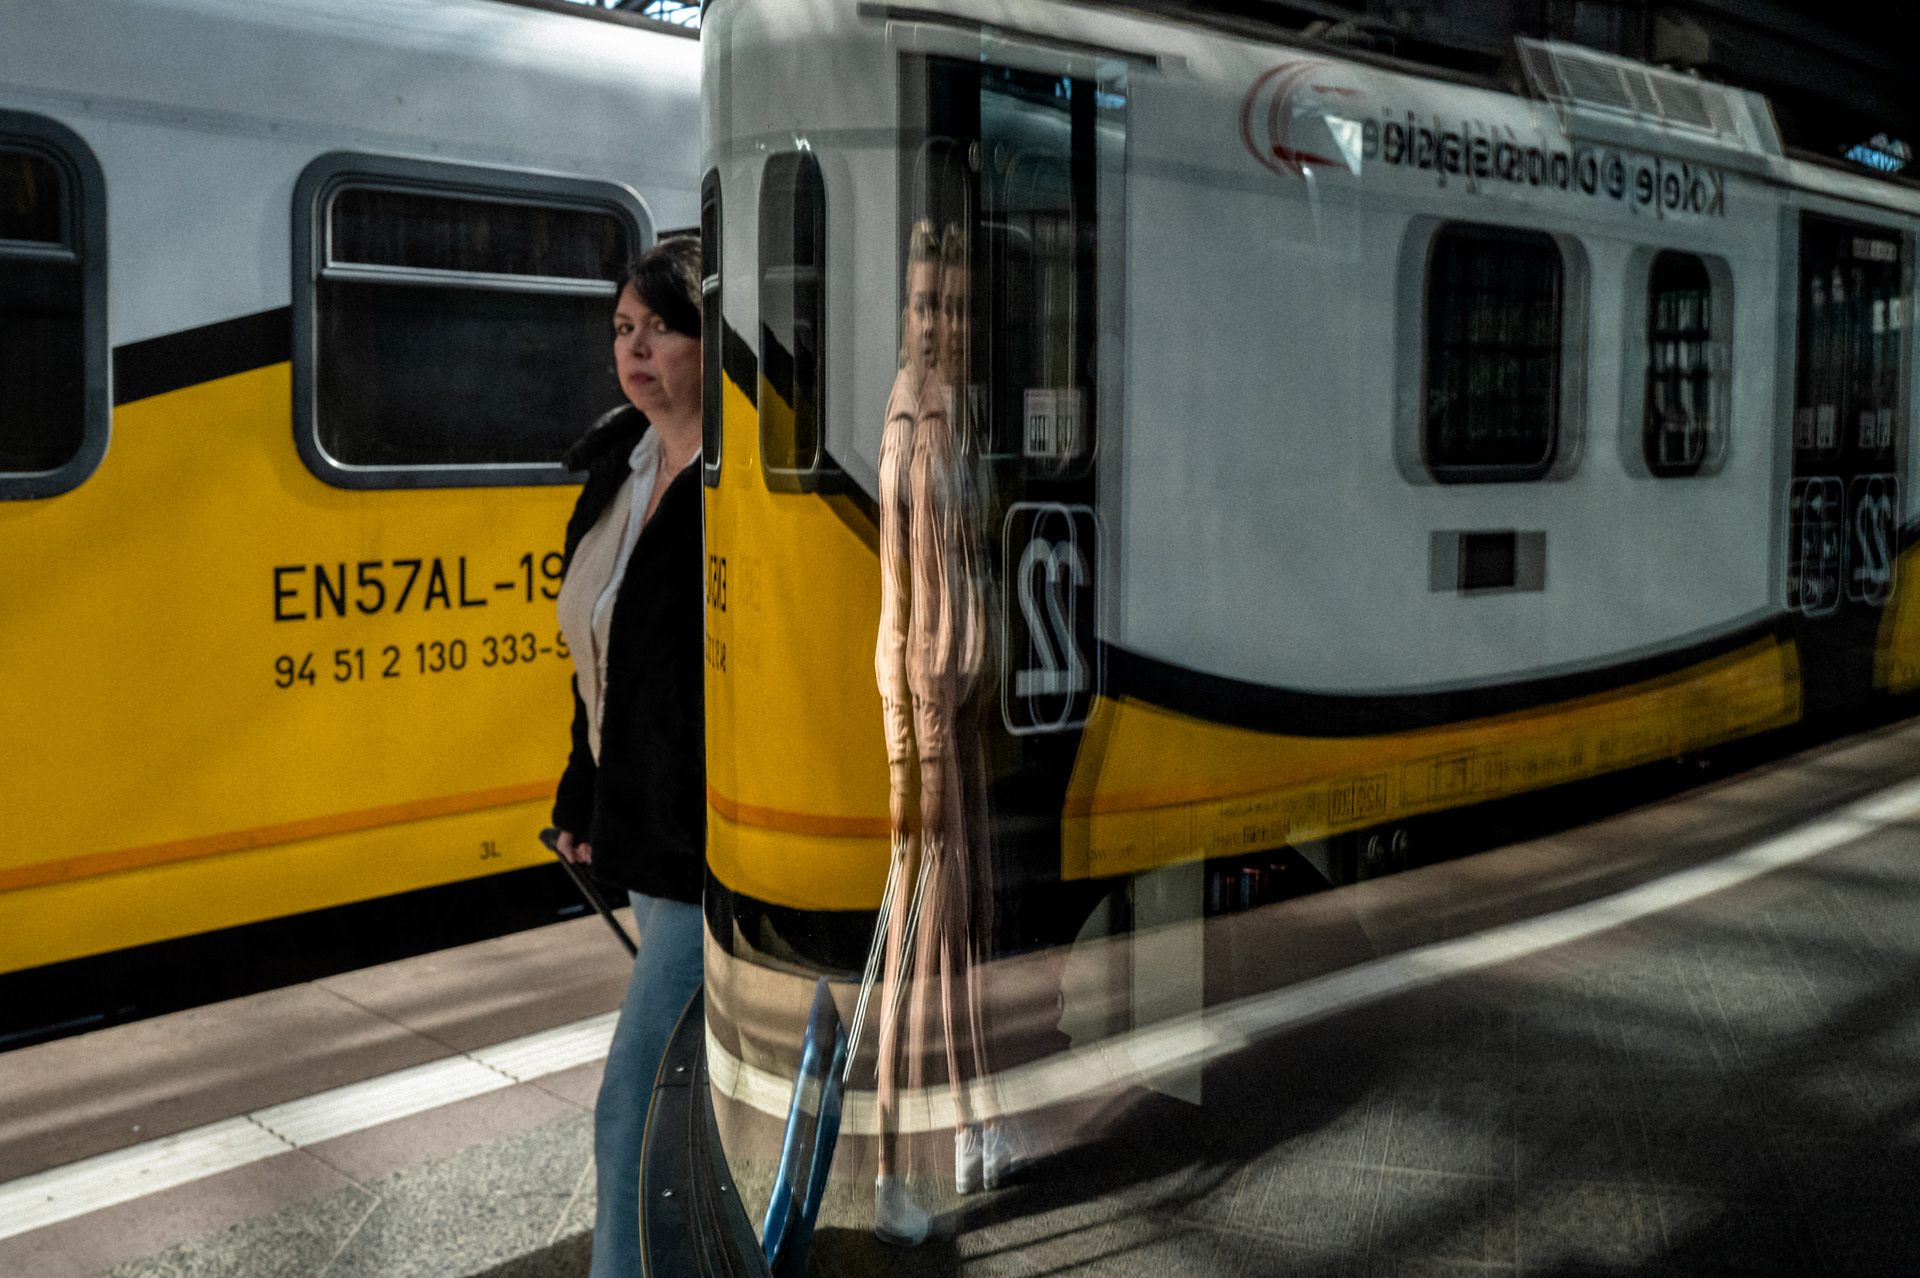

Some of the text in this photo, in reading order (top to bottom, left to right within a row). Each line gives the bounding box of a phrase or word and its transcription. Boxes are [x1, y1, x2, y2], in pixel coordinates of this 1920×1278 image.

[273, 552, 564, 622] EN57AL-19
[275, 653, 315, 689] 94
[333, 649, 365, 683] 51
[382, 646, 401, 678] 2
[416, 639, 467, 674] 130
[480, 840, 502, 860] 3L
